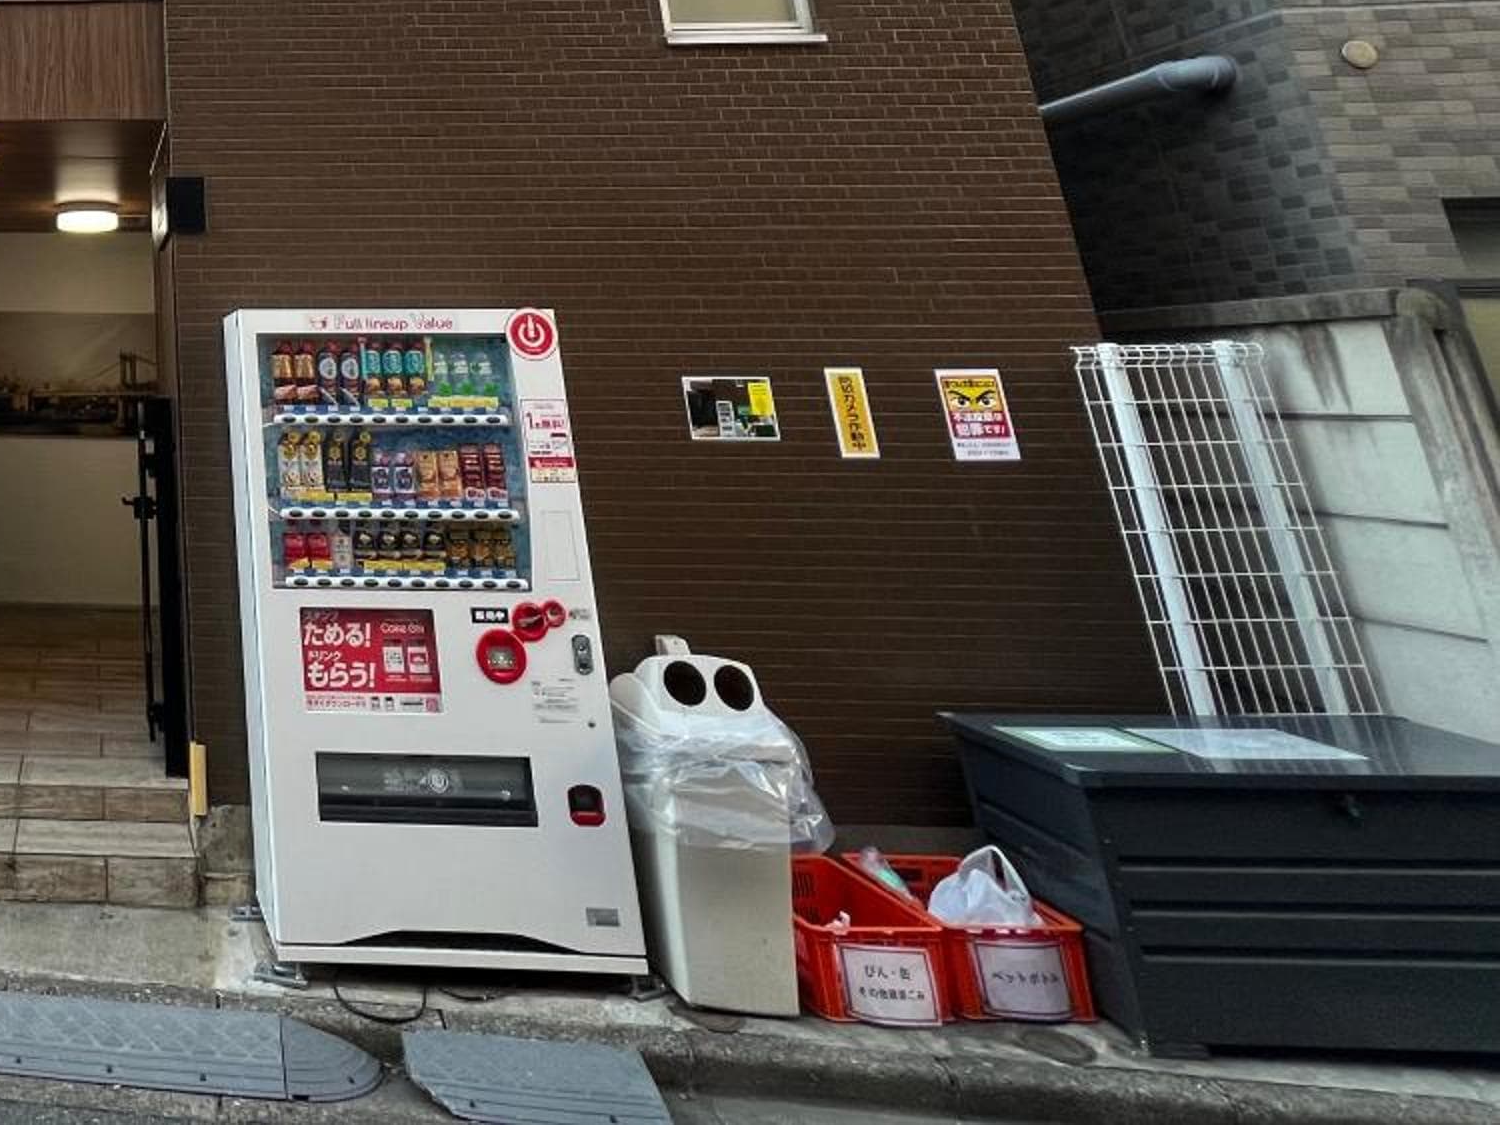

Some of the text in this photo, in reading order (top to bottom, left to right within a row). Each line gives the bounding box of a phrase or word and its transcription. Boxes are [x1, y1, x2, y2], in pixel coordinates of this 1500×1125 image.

[366, 316, 408, 331] lineup
[303, 622, 371, 648] ためる!
[308, 650, 342, 662] ドリンク
[308, 661, 376, 689] もらう!
